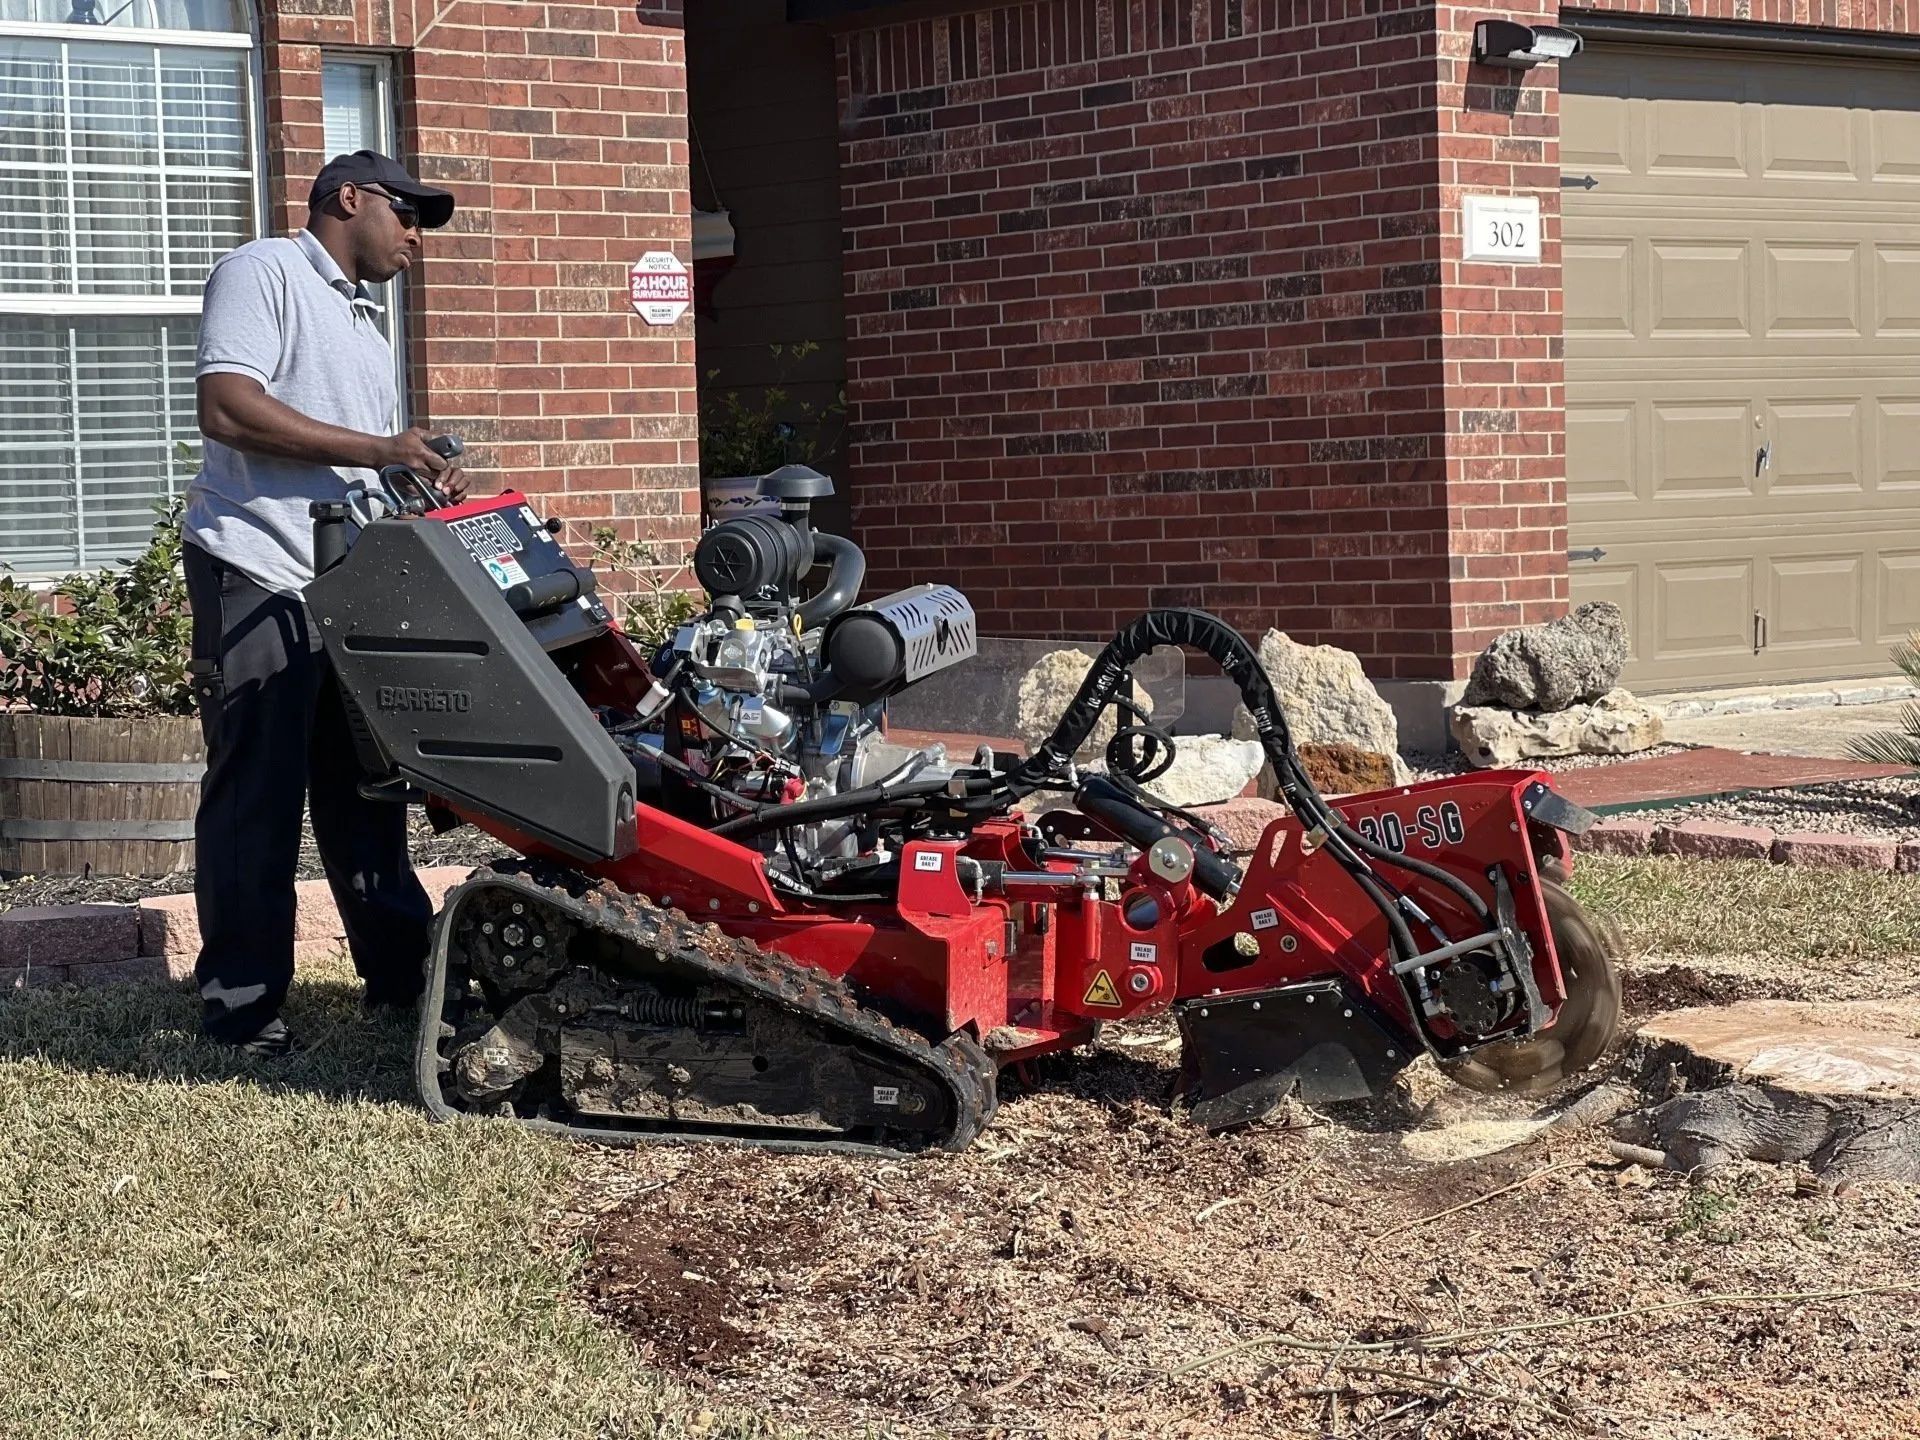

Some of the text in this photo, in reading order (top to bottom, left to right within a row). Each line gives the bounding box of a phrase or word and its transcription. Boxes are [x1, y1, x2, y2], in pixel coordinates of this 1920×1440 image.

[1488, 221, 1525, 248] 302
[631, 275, 688, 290] 24 HOUR
[632, 289, 690, 299] SURVEILLANCE
[446, 512, 523, 563] ARRETO
[376, 685, 472, 713] BARRETO
[1359, 800, 1465, 859] 30-SG
